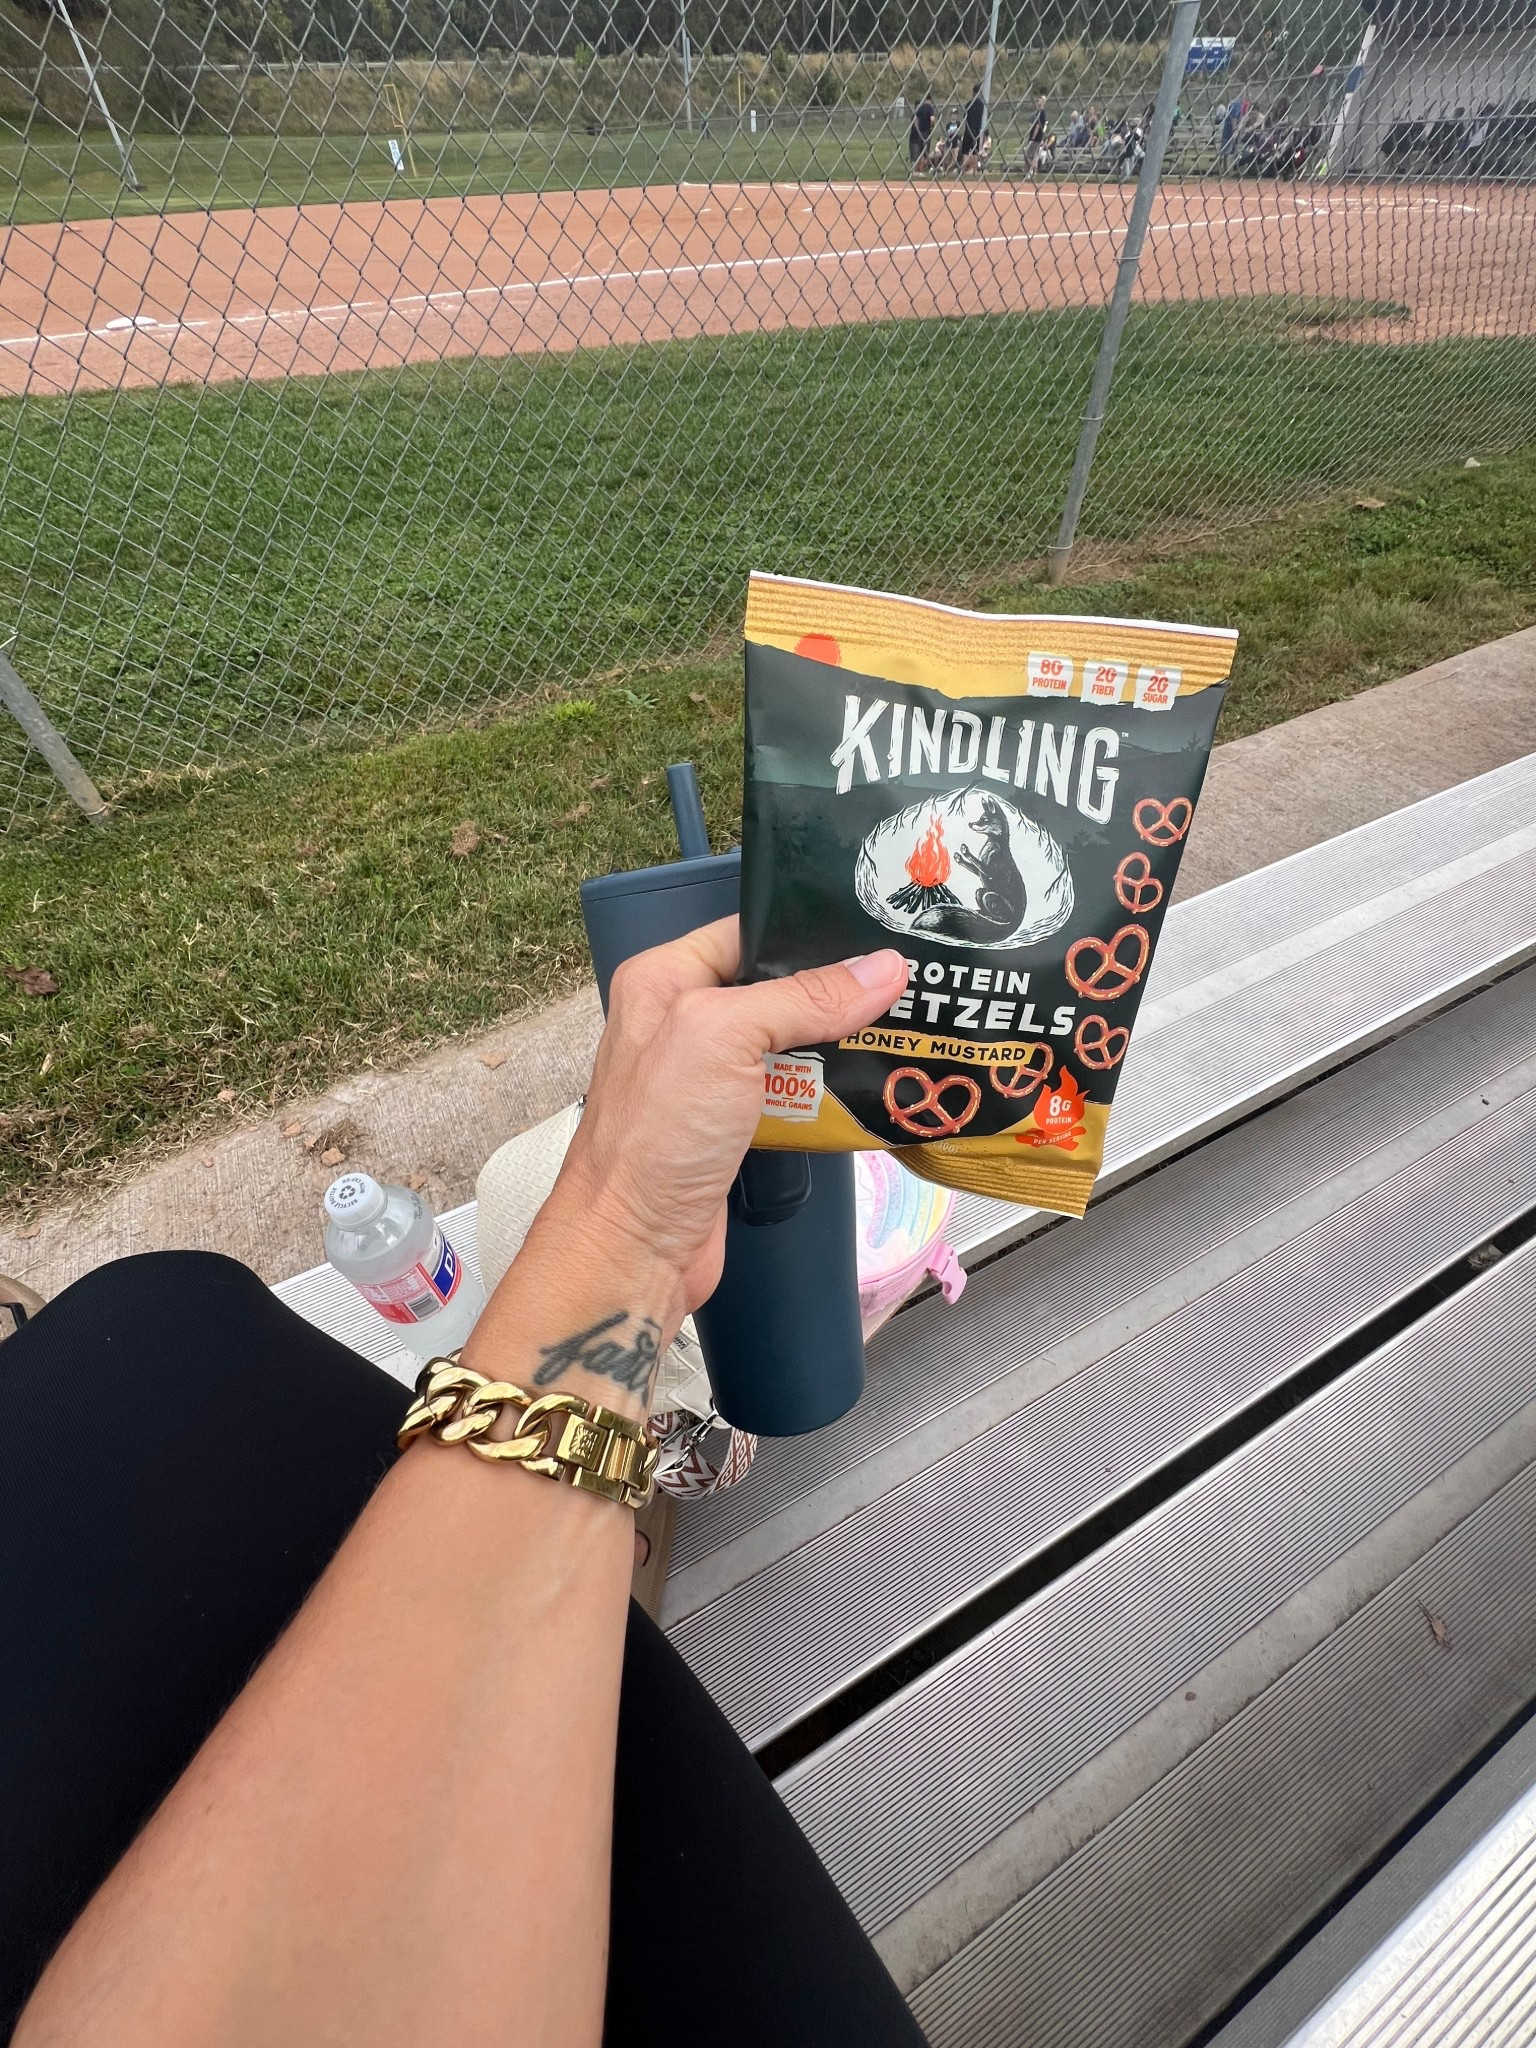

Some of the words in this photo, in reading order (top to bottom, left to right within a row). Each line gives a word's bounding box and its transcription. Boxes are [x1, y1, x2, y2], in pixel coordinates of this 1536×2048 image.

[1040, 659, 1064, 676] 8G
[1095, 666, 1117, 683] 2G
[1032, 677, 1067, 690] PROTEIN
[1091, 684, 1115, 696] FIBER
[1147, 676, 1169, 693] 2G
[1142, 693, 1168, 704] SUGAR
[830, 695, 1120, 825] KINDLING
[908, 958, 1031, 995] ROTEIN
[889, 989, 1077, 1036] ETZELS
[847, 1031, 922, 1051] HONEY
[930, 1041, 1026, 1061] MUSTARD
[774, 1062, 793, 1071] MADE
[795, 1065, 811, 1073] WITH
[765, 1073, 816, 1098] 100%
[765, 1099, 787, 1107] WHOLE
[788, 1102, 812, 1110] GRAINS
[1049, 1095, 1072, 1117] 8G
[1045, 1116, 1072, 1125] PROTEIN
[334, 1198, 358, 1209] RECYCLE
